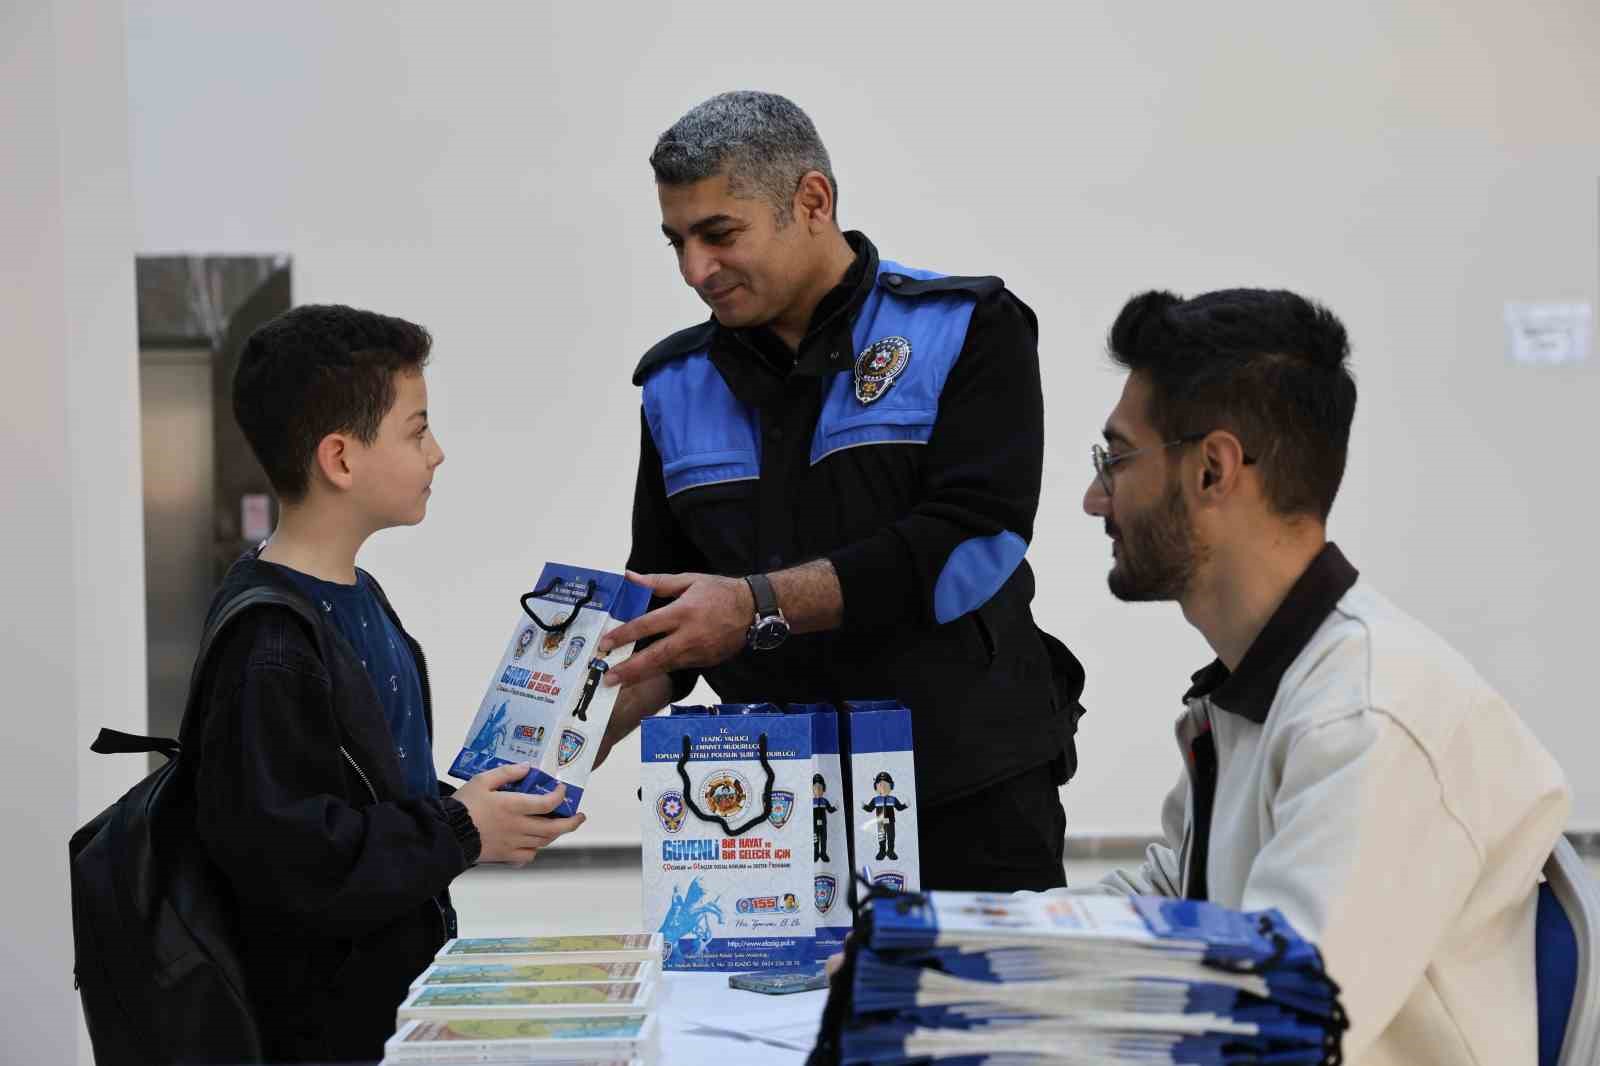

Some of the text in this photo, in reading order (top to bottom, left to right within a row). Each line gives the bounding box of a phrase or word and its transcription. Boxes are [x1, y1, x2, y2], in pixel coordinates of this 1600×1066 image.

[662, 839, 720, 861] GÜVENLİ
[721, 838, 736, 849] BİR
[738, 838, 763, 849] HAYAT
[721, 847, 791, 860] BİR GELECEK İÇİN
[752, 898, 776, 909] 155
